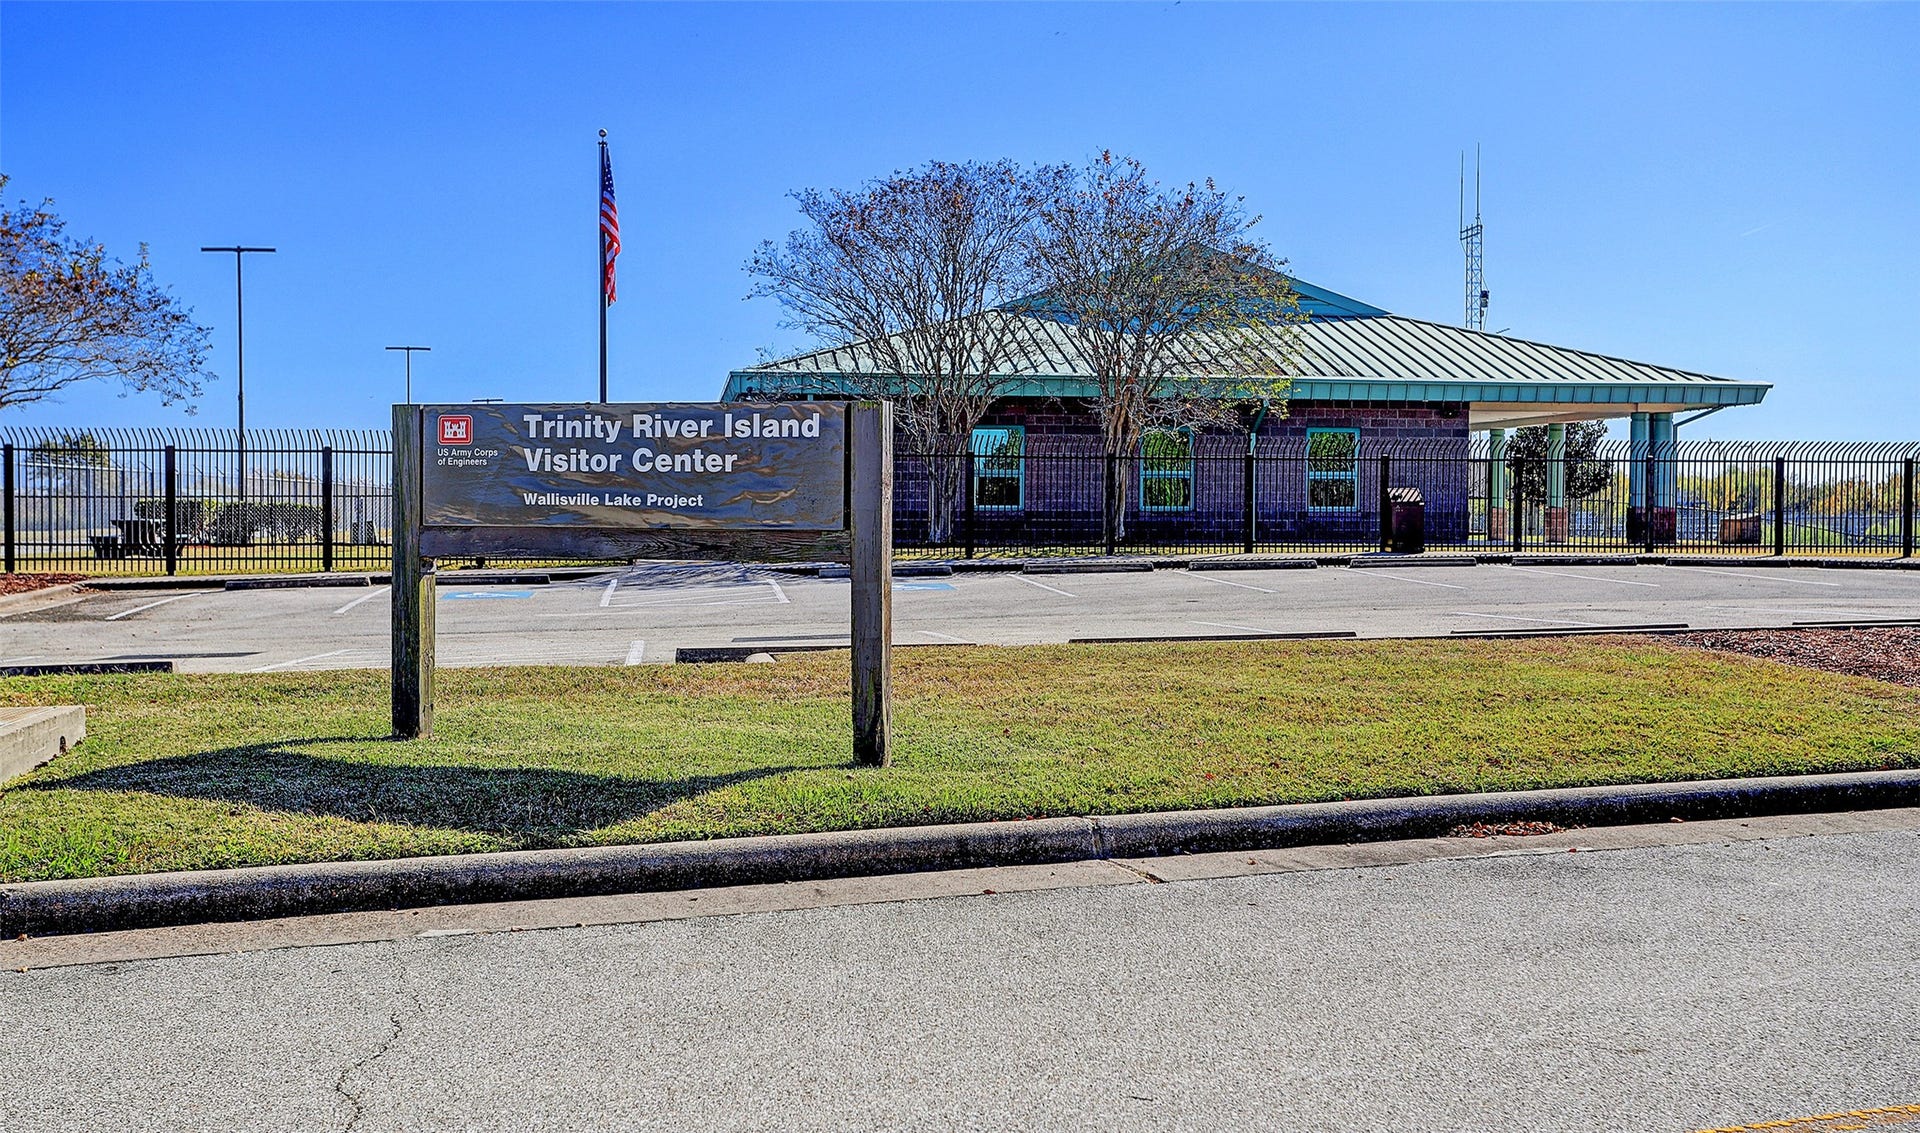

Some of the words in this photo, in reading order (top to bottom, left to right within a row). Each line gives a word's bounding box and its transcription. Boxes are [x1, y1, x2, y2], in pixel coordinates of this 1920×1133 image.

[523, 414, 622, 443] Trinity
[632, 414, 713, 438] River
[724, 413, 820, 438] Island
[437, 448, 449, 457] US
[451, 448, 472, 458] Army
[474, 448, 499, 458] Corps
[523, 447, 622, 473] Visitor
[632, 447, 738, 473] Center
[437, 458, 446, 466] of
[447, 458, 488, 468] Engineers
[523, 493, 600, 506] Wallisville
[604, 493, 642, 506] Lake
[646, 493, 703, 509] Project
